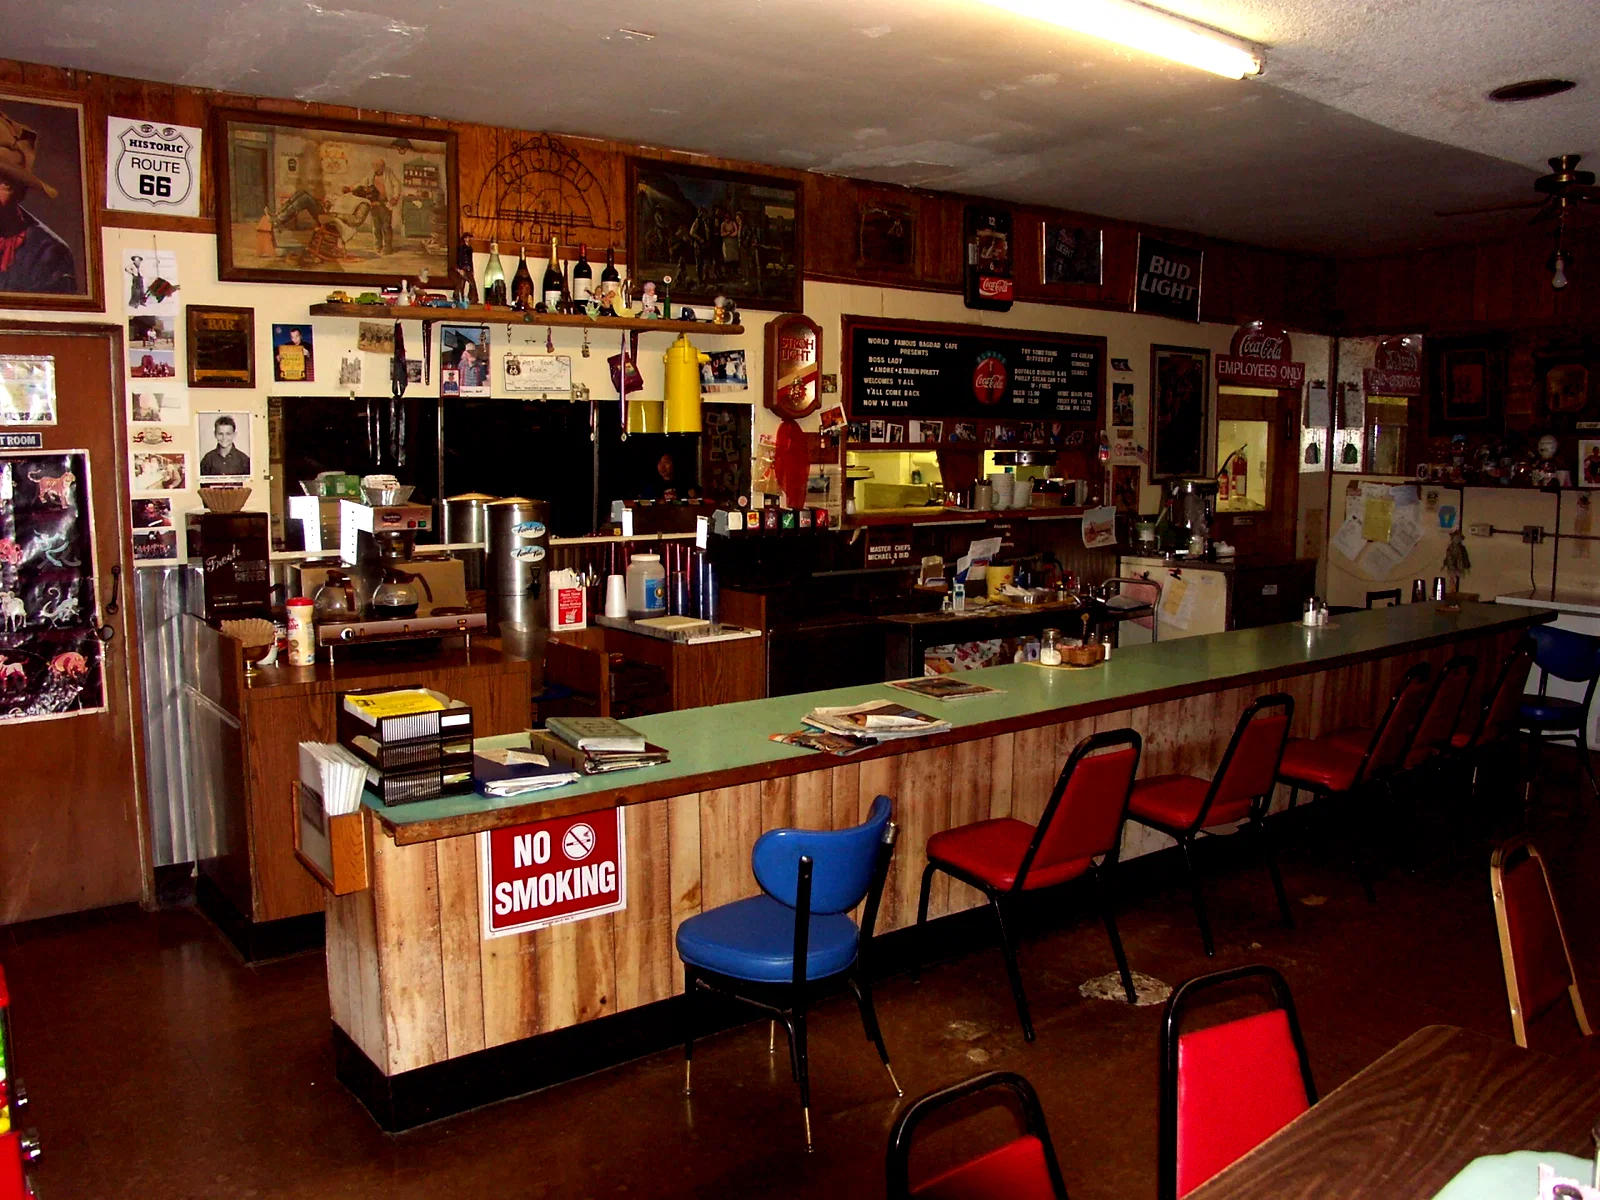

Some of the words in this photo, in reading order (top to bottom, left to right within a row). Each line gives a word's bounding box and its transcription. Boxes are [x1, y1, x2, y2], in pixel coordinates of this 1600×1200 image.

[129, 138, 184, 153] HISTORIC
[131, 157, 181, 174] ROUTE
[139, 174, 172, 197] 66
[1149, 255, 1191, 280] BUD
[982, 276, 1013, 293] Coca-Cola
[1140, 272, 1196, 301] LIGHT
[208, 319, 236, 331] BAR
[867, 337, 890, 346] WORLD
[894, 339, 917, 348] FAMOUS
[919, 341, 942, 350] BAGDAD
[945, 342, 958, 350] CAFE
[1239, 335, 1284, 360] Coca-Cola
[900, 348, 929, 357] PRESENTS
[888, 357, 902, 365] LADY
[1218, 360, 1277, 379] EMPLOYEES
[1280, 369, 1303, 381] ONLY
[863, 377, 894, 385] WELCOMES
[975, 373, 1005, 390] Coca-Cola
[885, 389, 902, 397] COME
[904, 390, 921, 398] BACK
[863, 399, 878, 407] NOW
[8, 435, 36, 447] ROOM
[867, 552, 893, 561] MICHAEL
[869, 545, 892, 553] MASTER
[513, 830, 551, 868] NO
[495, 860, 616, 915] SMOKING
